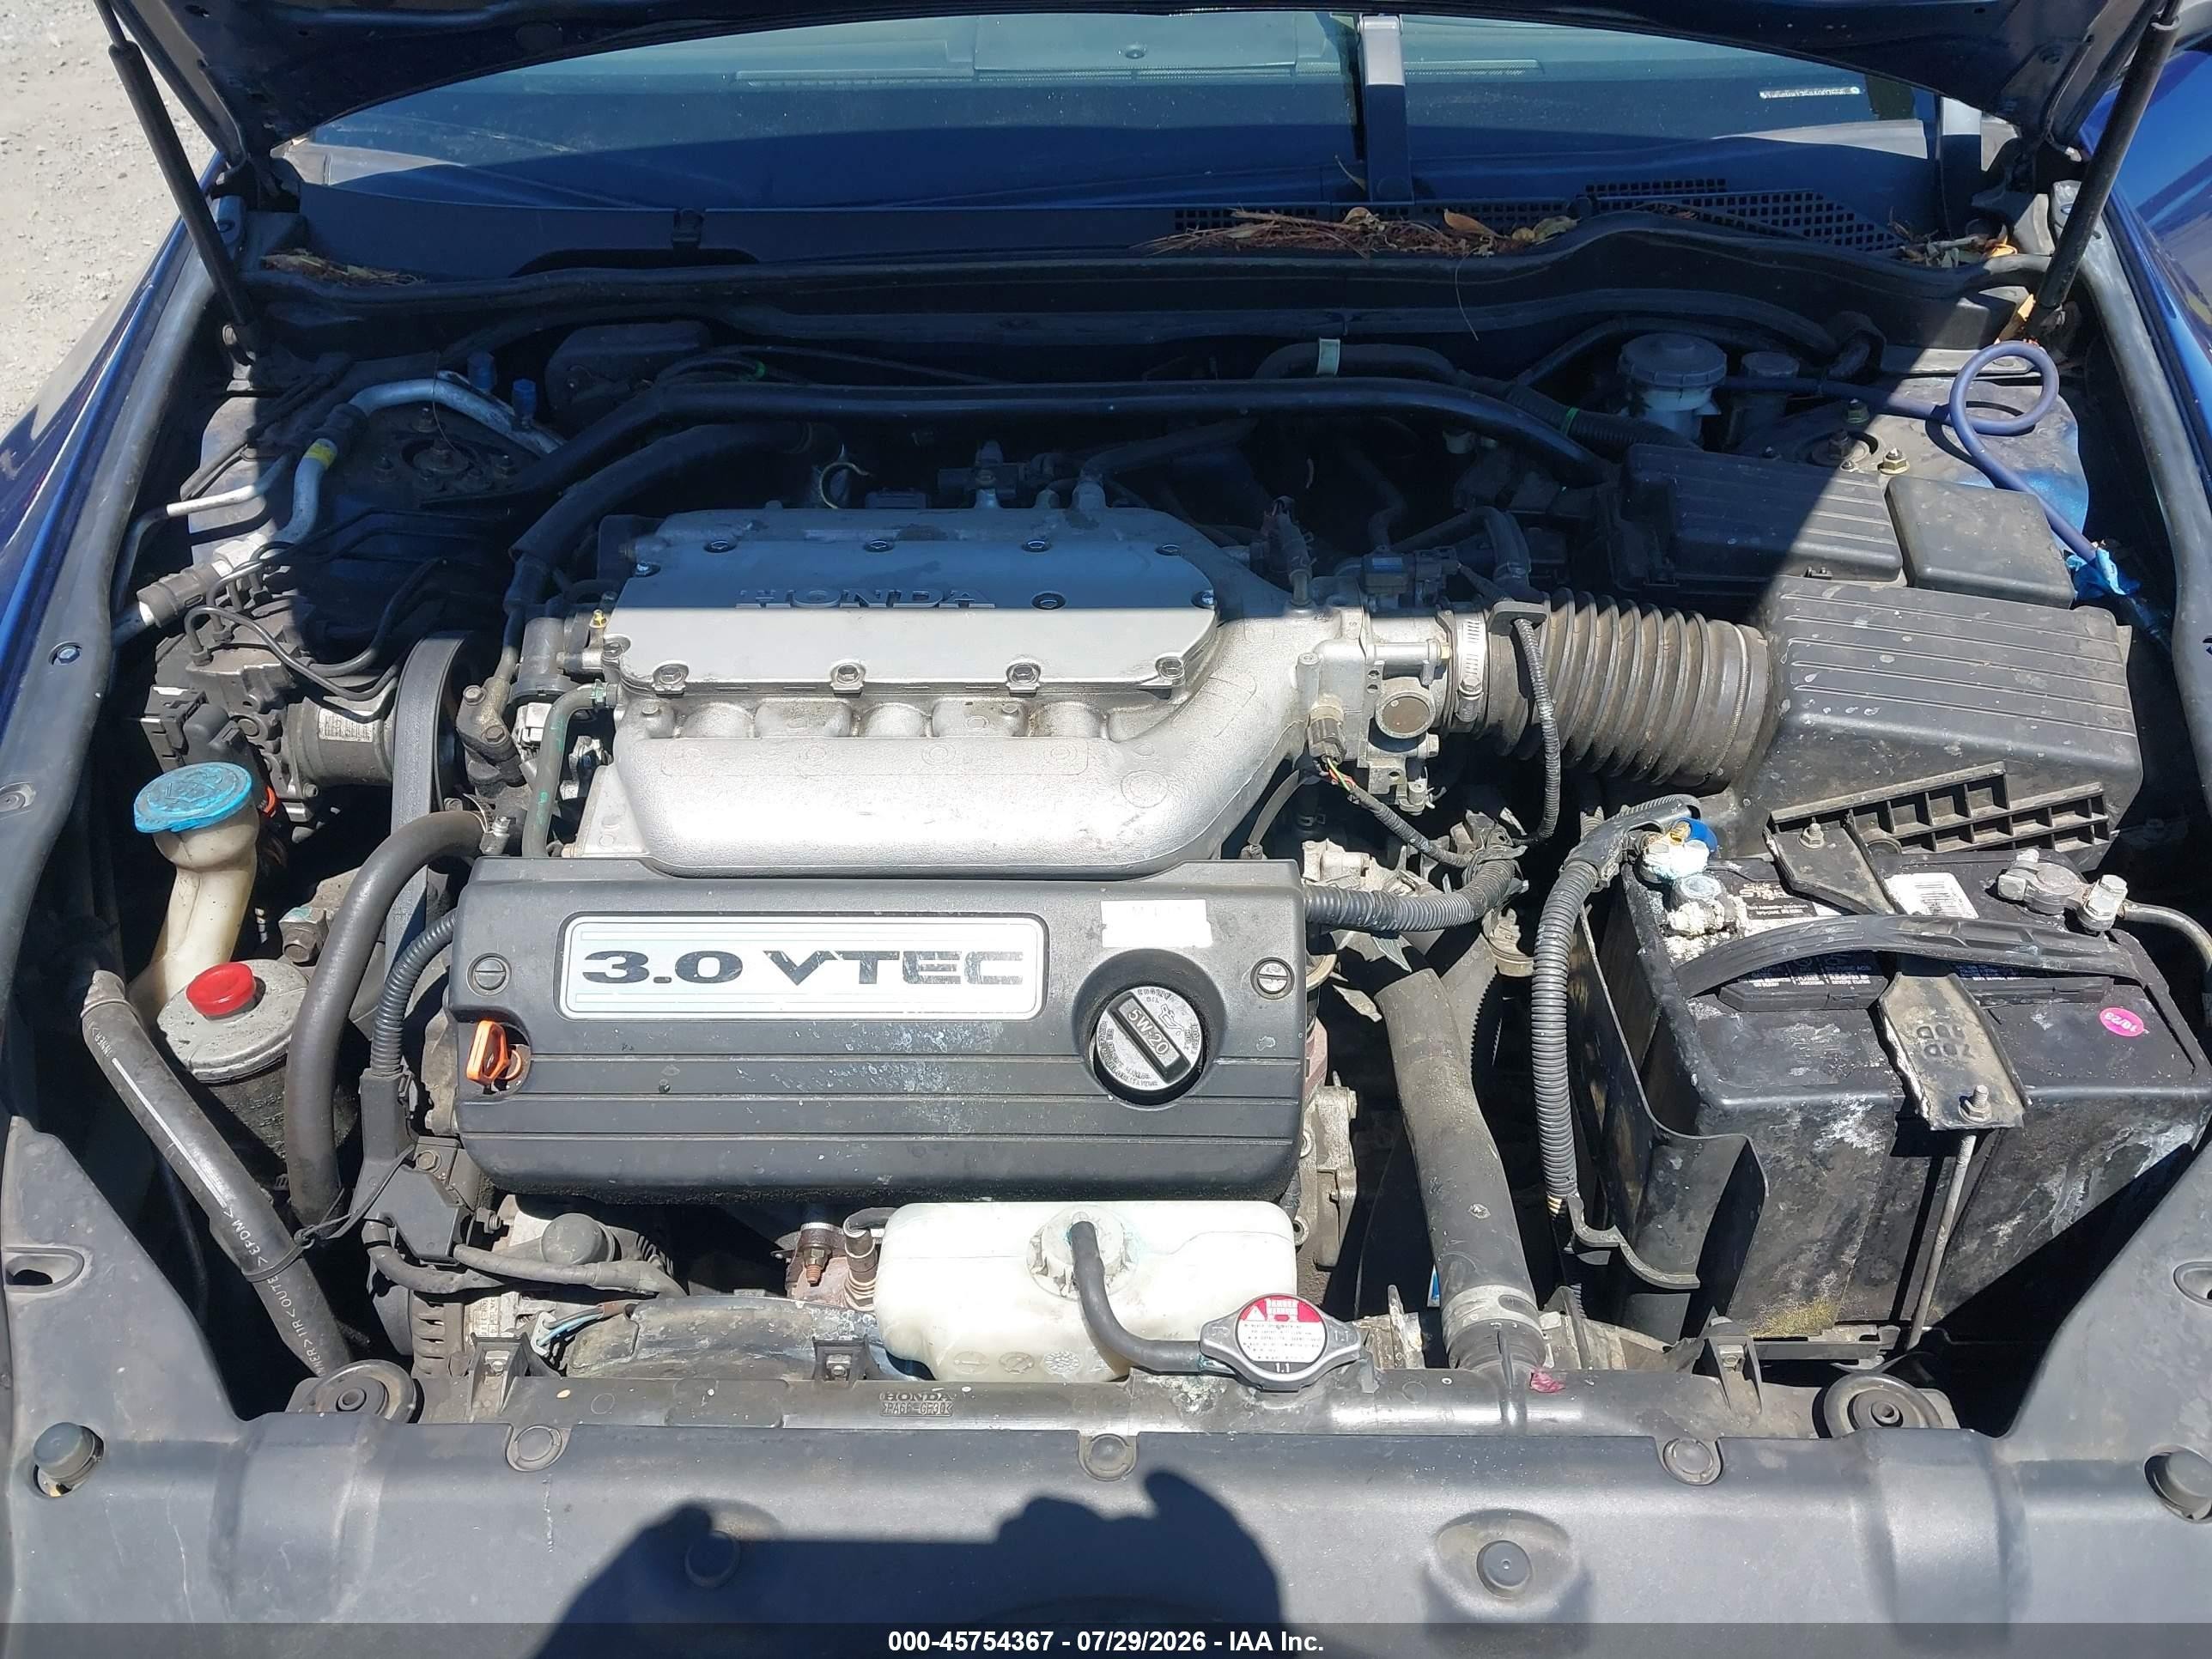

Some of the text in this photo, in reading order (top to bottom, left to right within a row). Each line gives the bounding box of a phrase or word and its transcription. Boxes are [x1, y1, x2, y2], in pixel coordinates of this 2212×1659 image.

[735, 589, 996, 609] HONDA
[581, 950, 1024, 986] 3.0 VTEC
[1127, 1008, 1170, 1055] 5W-20
[1275, 1362, 1290, 1373] 1.1
[878, 1391, 957, 1401] HONDA
